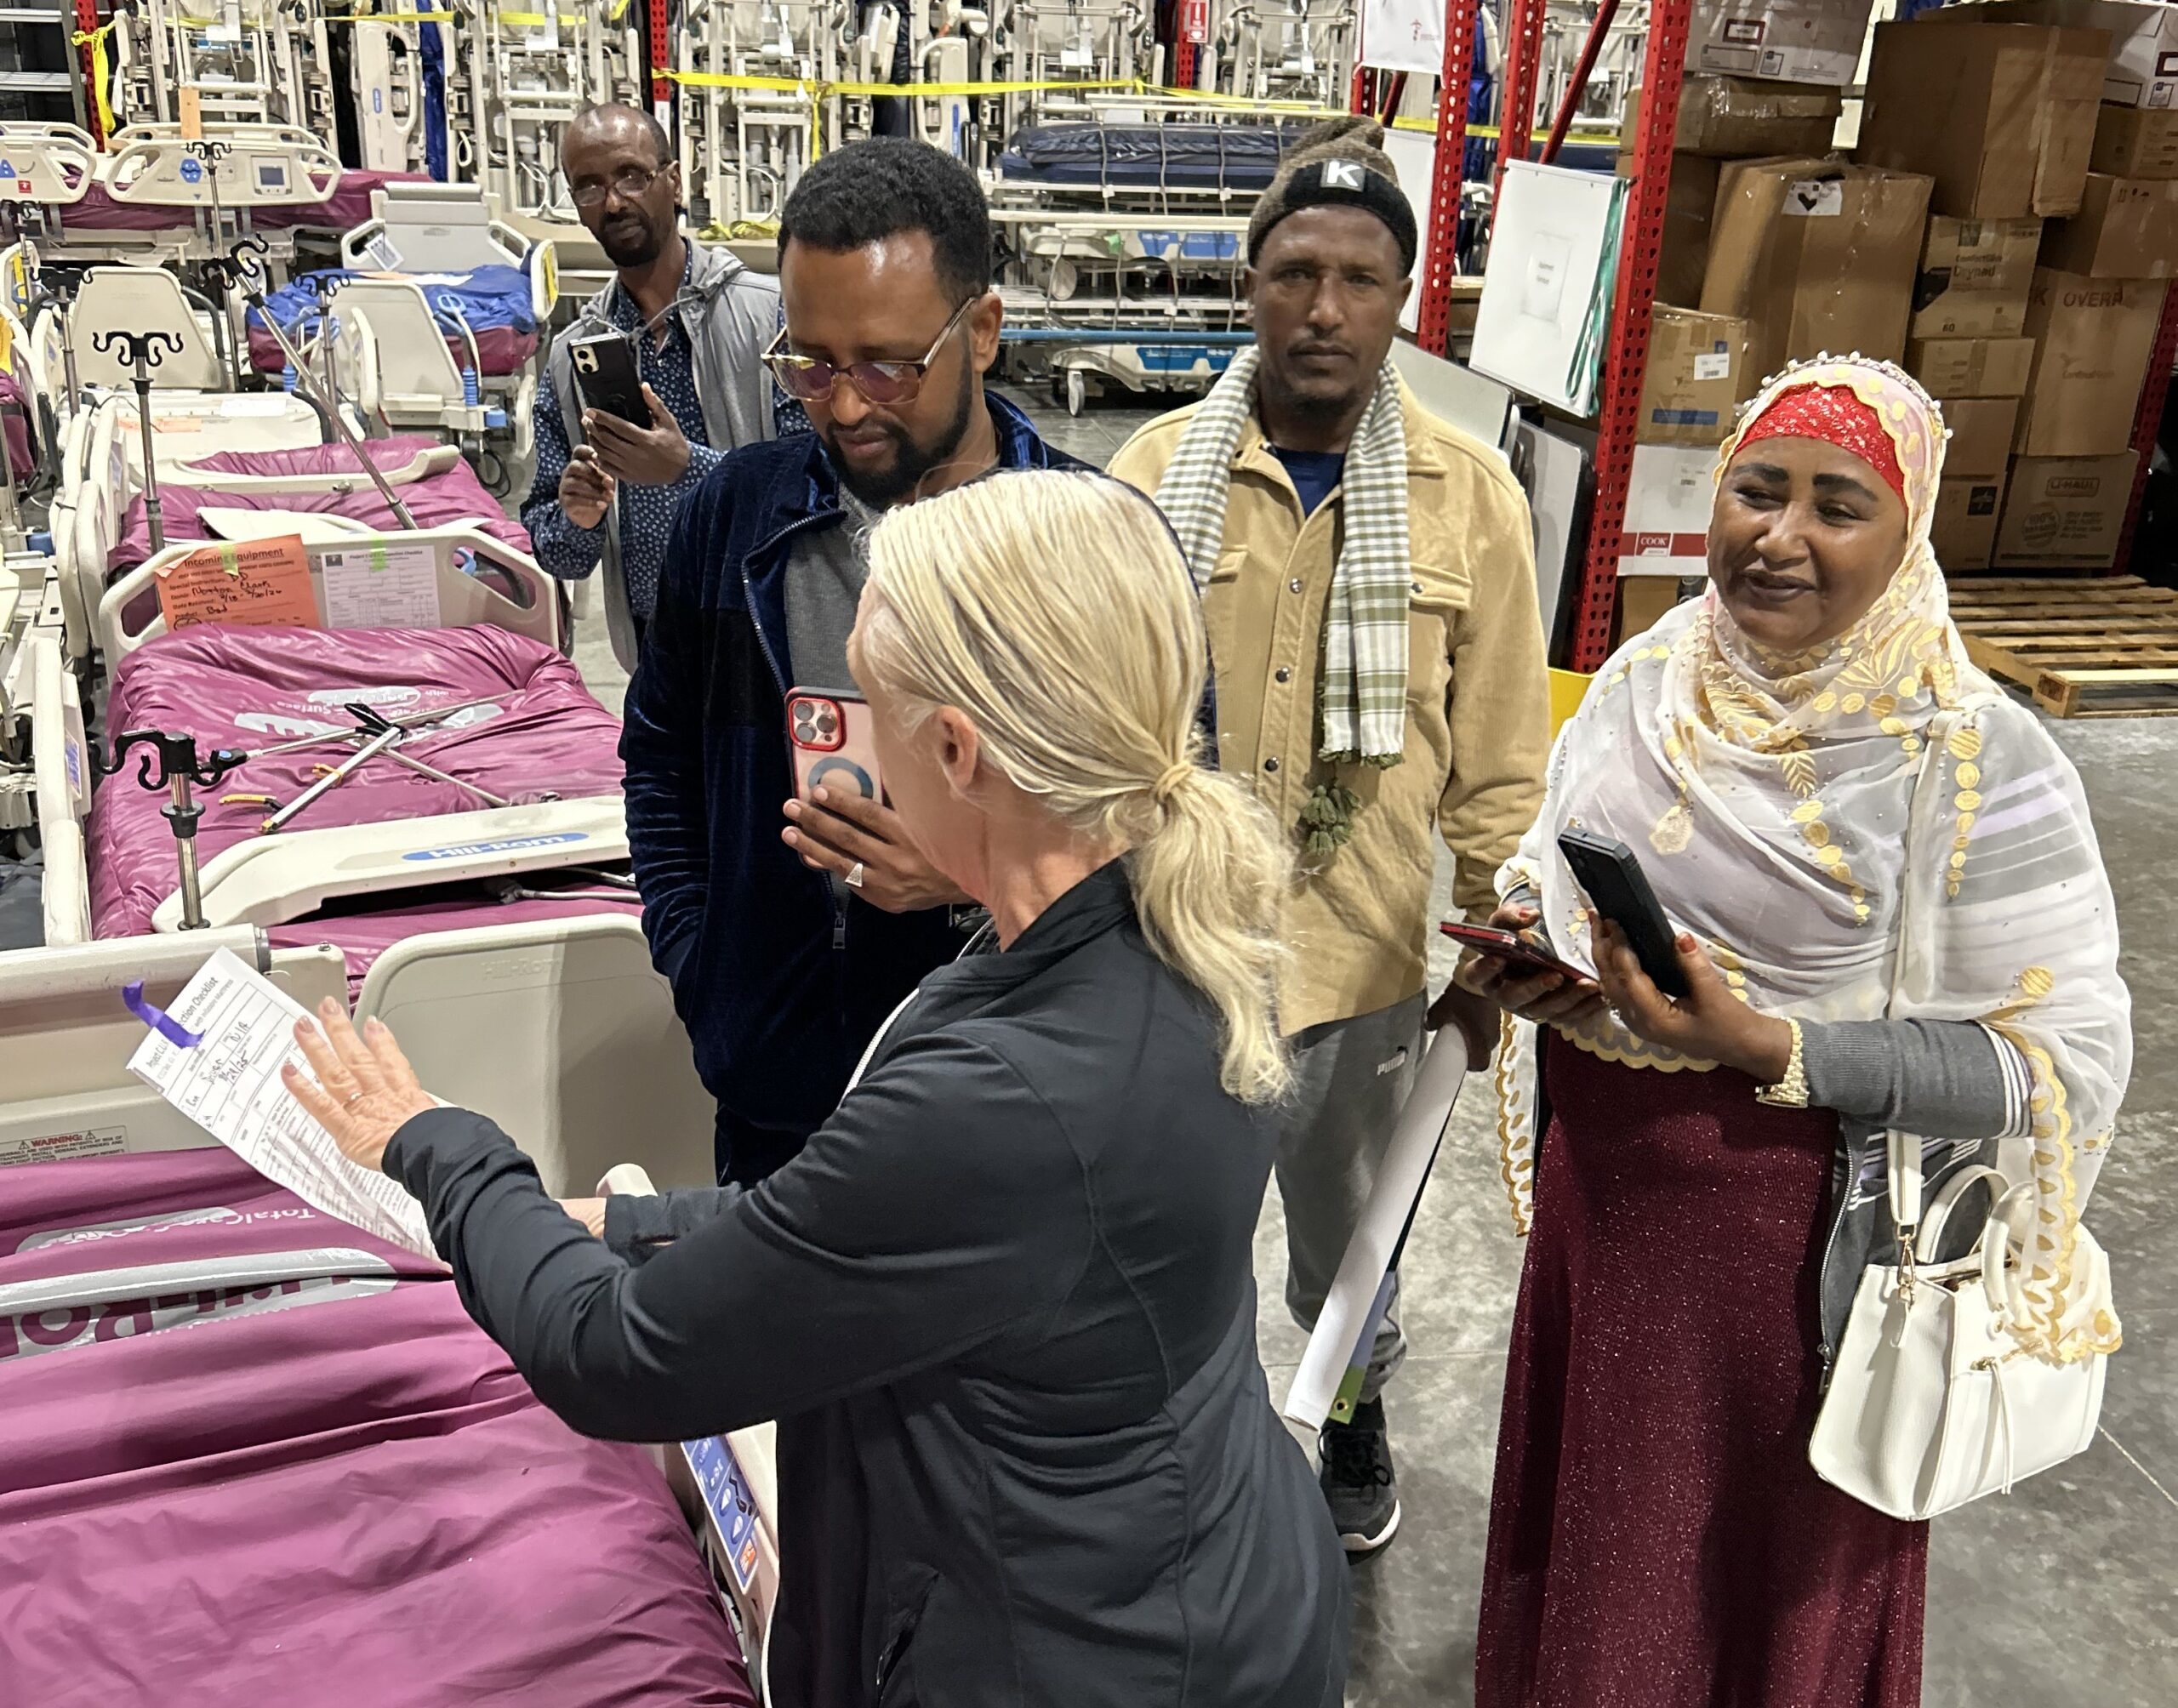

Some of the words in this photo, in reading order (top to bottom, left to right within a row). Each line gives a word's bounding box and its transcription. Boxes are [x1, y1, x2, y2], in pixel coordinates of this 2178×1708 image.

[1326, 160, 1360, 187] K
[2050, 481, 2095, 490] U-HAUL
[1640, 537, 1666, 546] COOK
[428, 835, 566, 858] Hill-Rom
[191, 976, 219, 1007] Checklist
